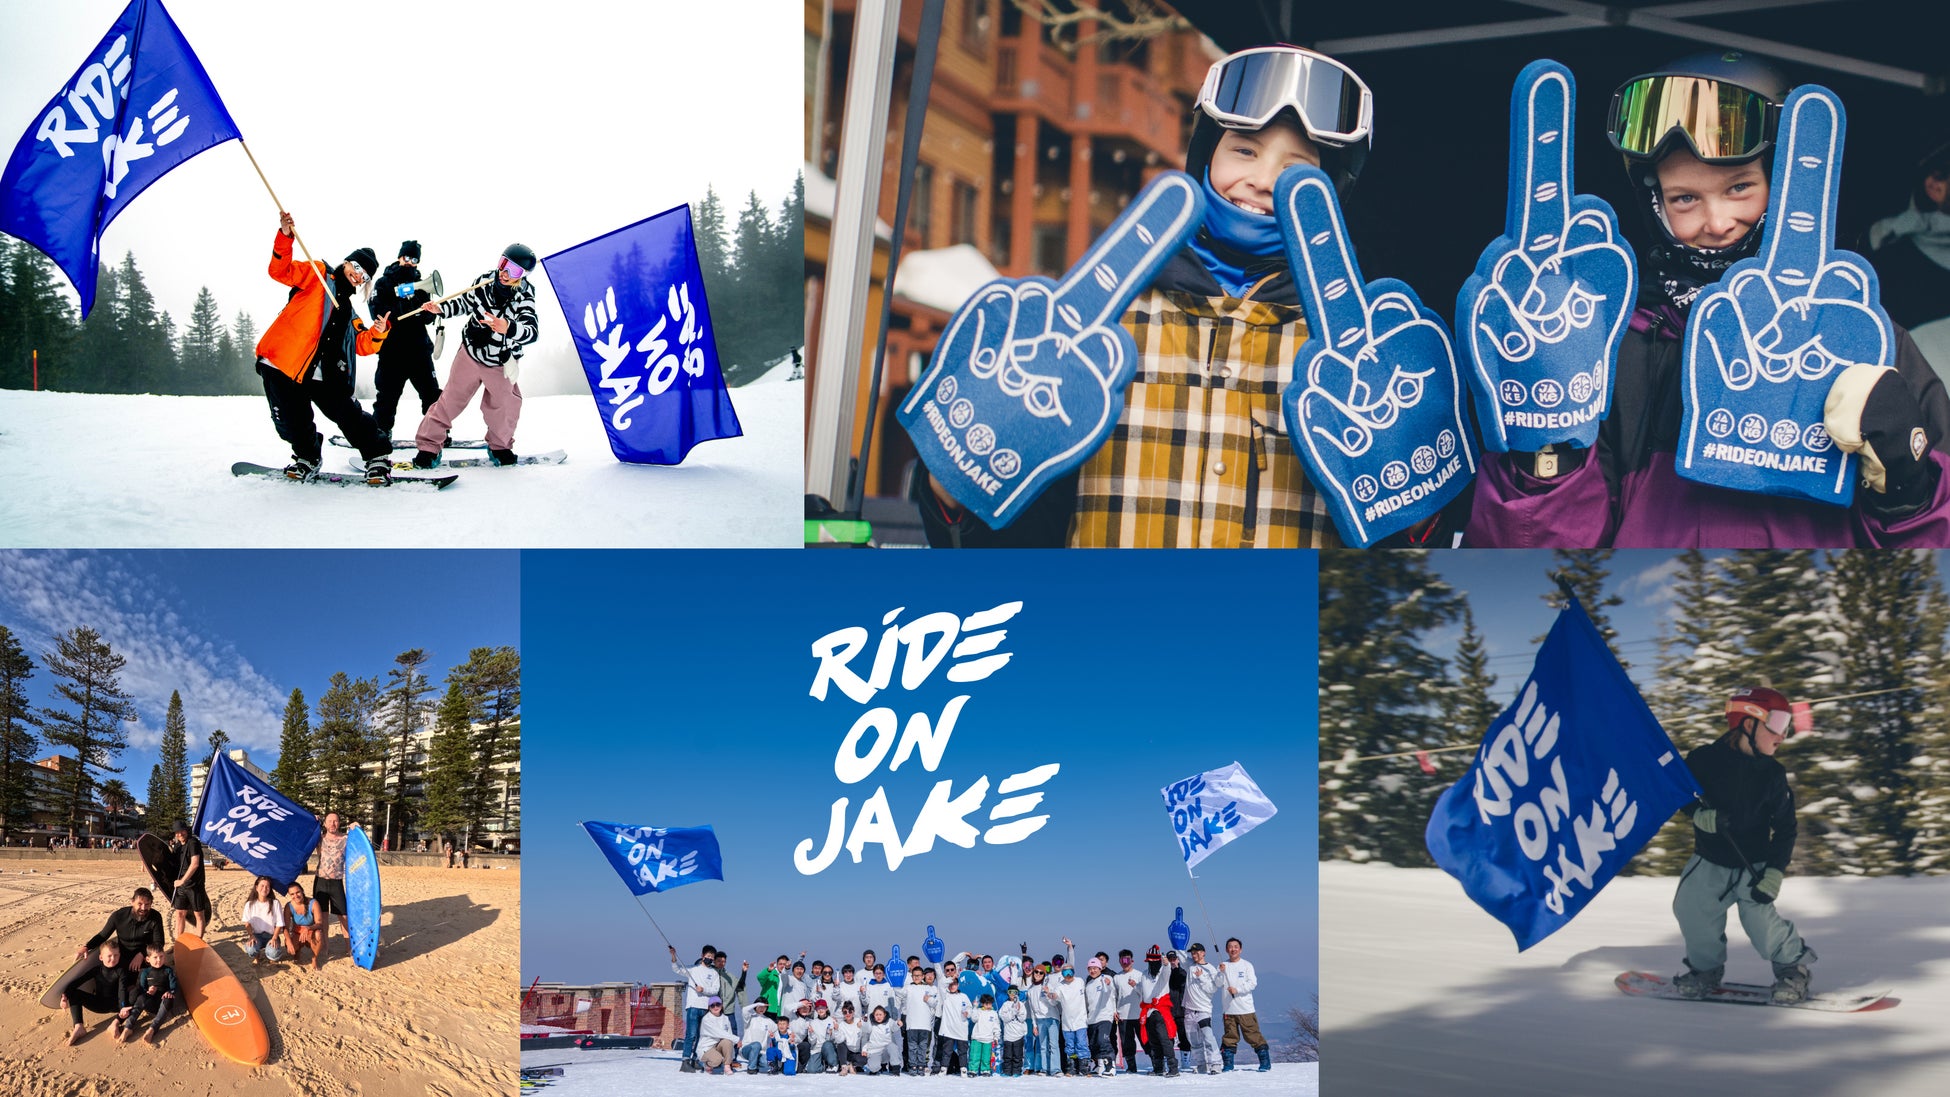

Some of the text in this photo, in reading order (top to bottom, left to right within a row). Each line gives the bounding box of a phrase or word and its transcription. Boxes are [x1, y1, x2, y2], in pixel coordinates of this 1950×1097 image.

[922, 399, 1004, 497] #RIDEONJAKE
[1703, 443, 1828, 473] #RIDEONJAKE
[1364, 455, 1462, 522] #RIDEONJAKE
[1473, 680, 1560, 825] RIDE
[228, 805, 270, 828] ON
[236, 784, 294, 821] RIDE
[1174, 797, 1203, 834] ON
[1514, 755, 1570, 861] ON
[205, 818, 278, 859] JAKE
[1181, 801, 1241, 862] JAKE
[1543, 768, 1638, 915] JAKE
[628, 839, 664, 866] ON
[633, 850, 698, 887] JAKE
